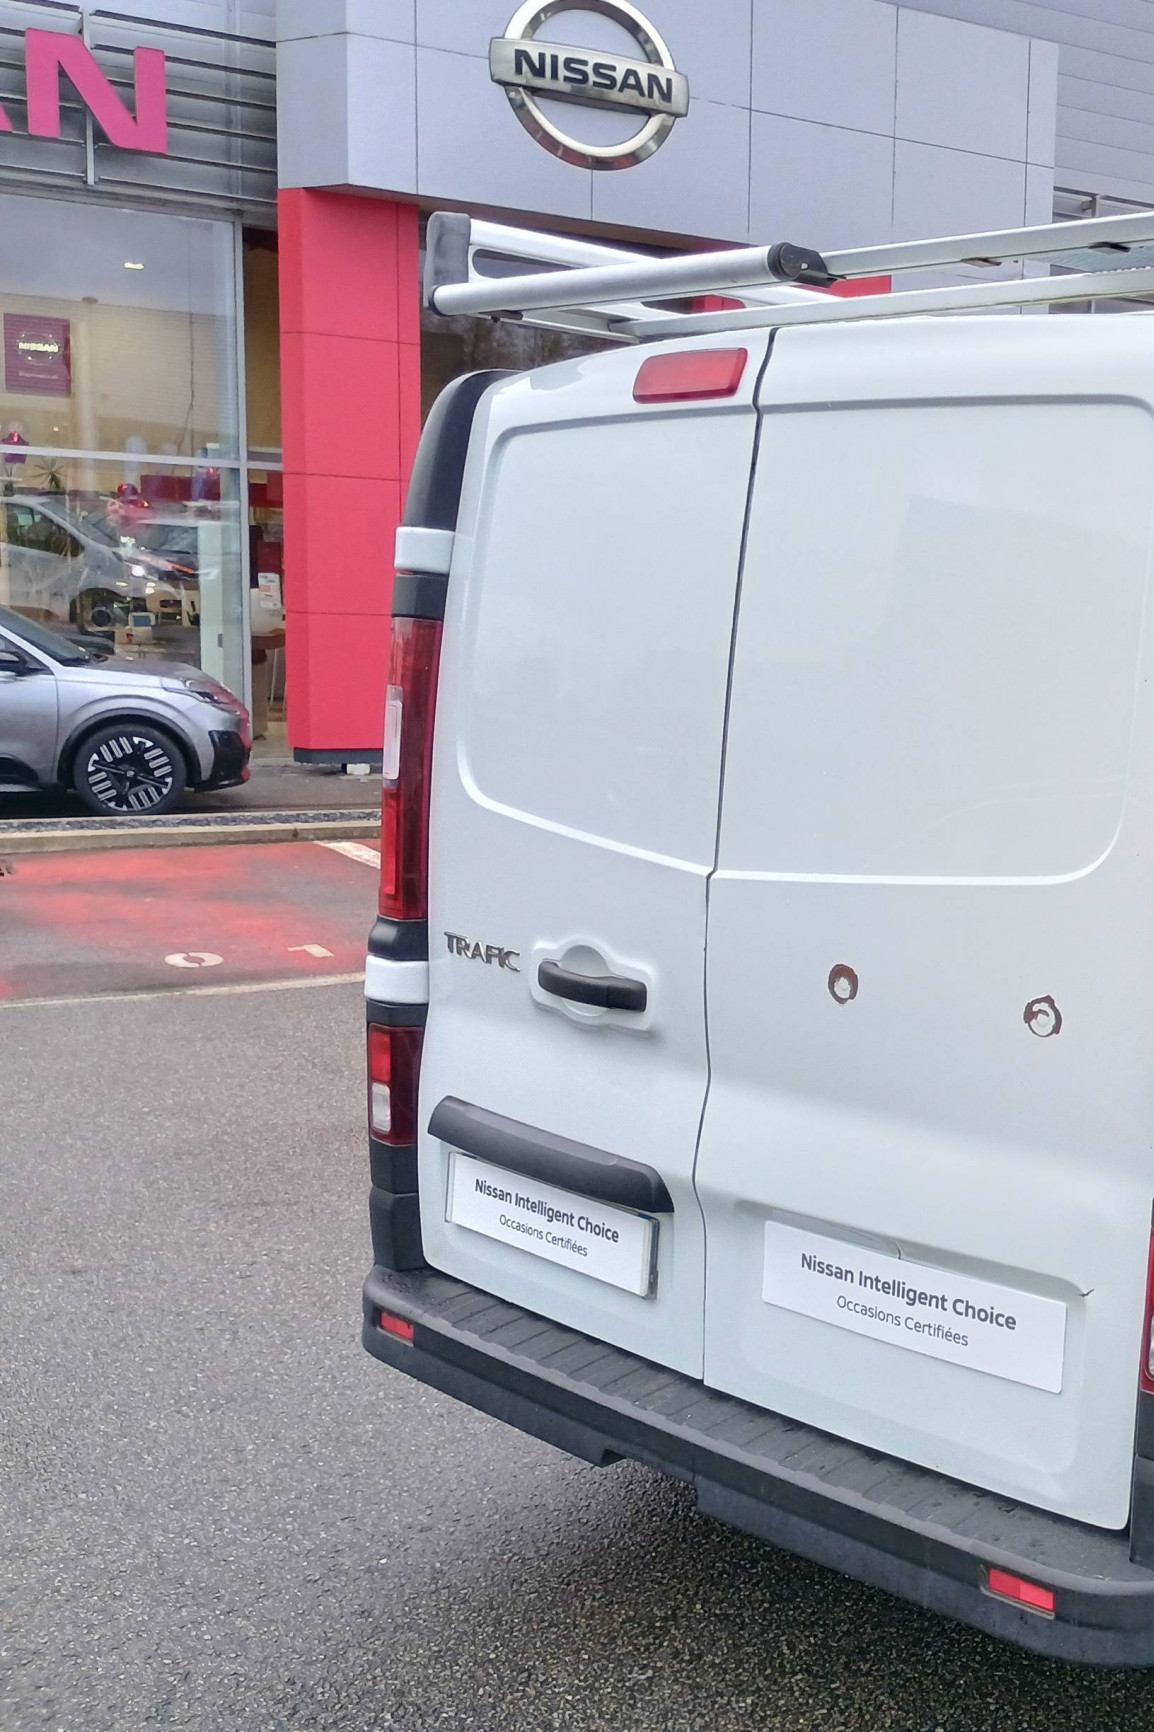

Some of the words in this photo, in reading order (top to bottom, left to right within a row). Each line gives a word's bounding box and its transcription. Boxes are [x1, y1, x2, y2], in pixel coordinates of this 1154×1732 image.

[513, 48, 673, 104] NISSAN
[443, 931, 521, 972] TRAFIC
[475, 1178, 512, 1204] Nissan
[514, 1192, 575, 1227] Intelligent
[577, 1216, 620, 1243] Choice
[499, 1214, 544, 1240] Occasions
[545, 1232, 588, 1257] Certifiées
[800, 1252, 854, 1284] Nissan
[858, 1270, 948, 1312] Intelligent
[952, 1298, 1017, 1331] Choice
[836, 1295, 902, 1327] Occasions
[904, 1315, 969, 1347] Certifiées
